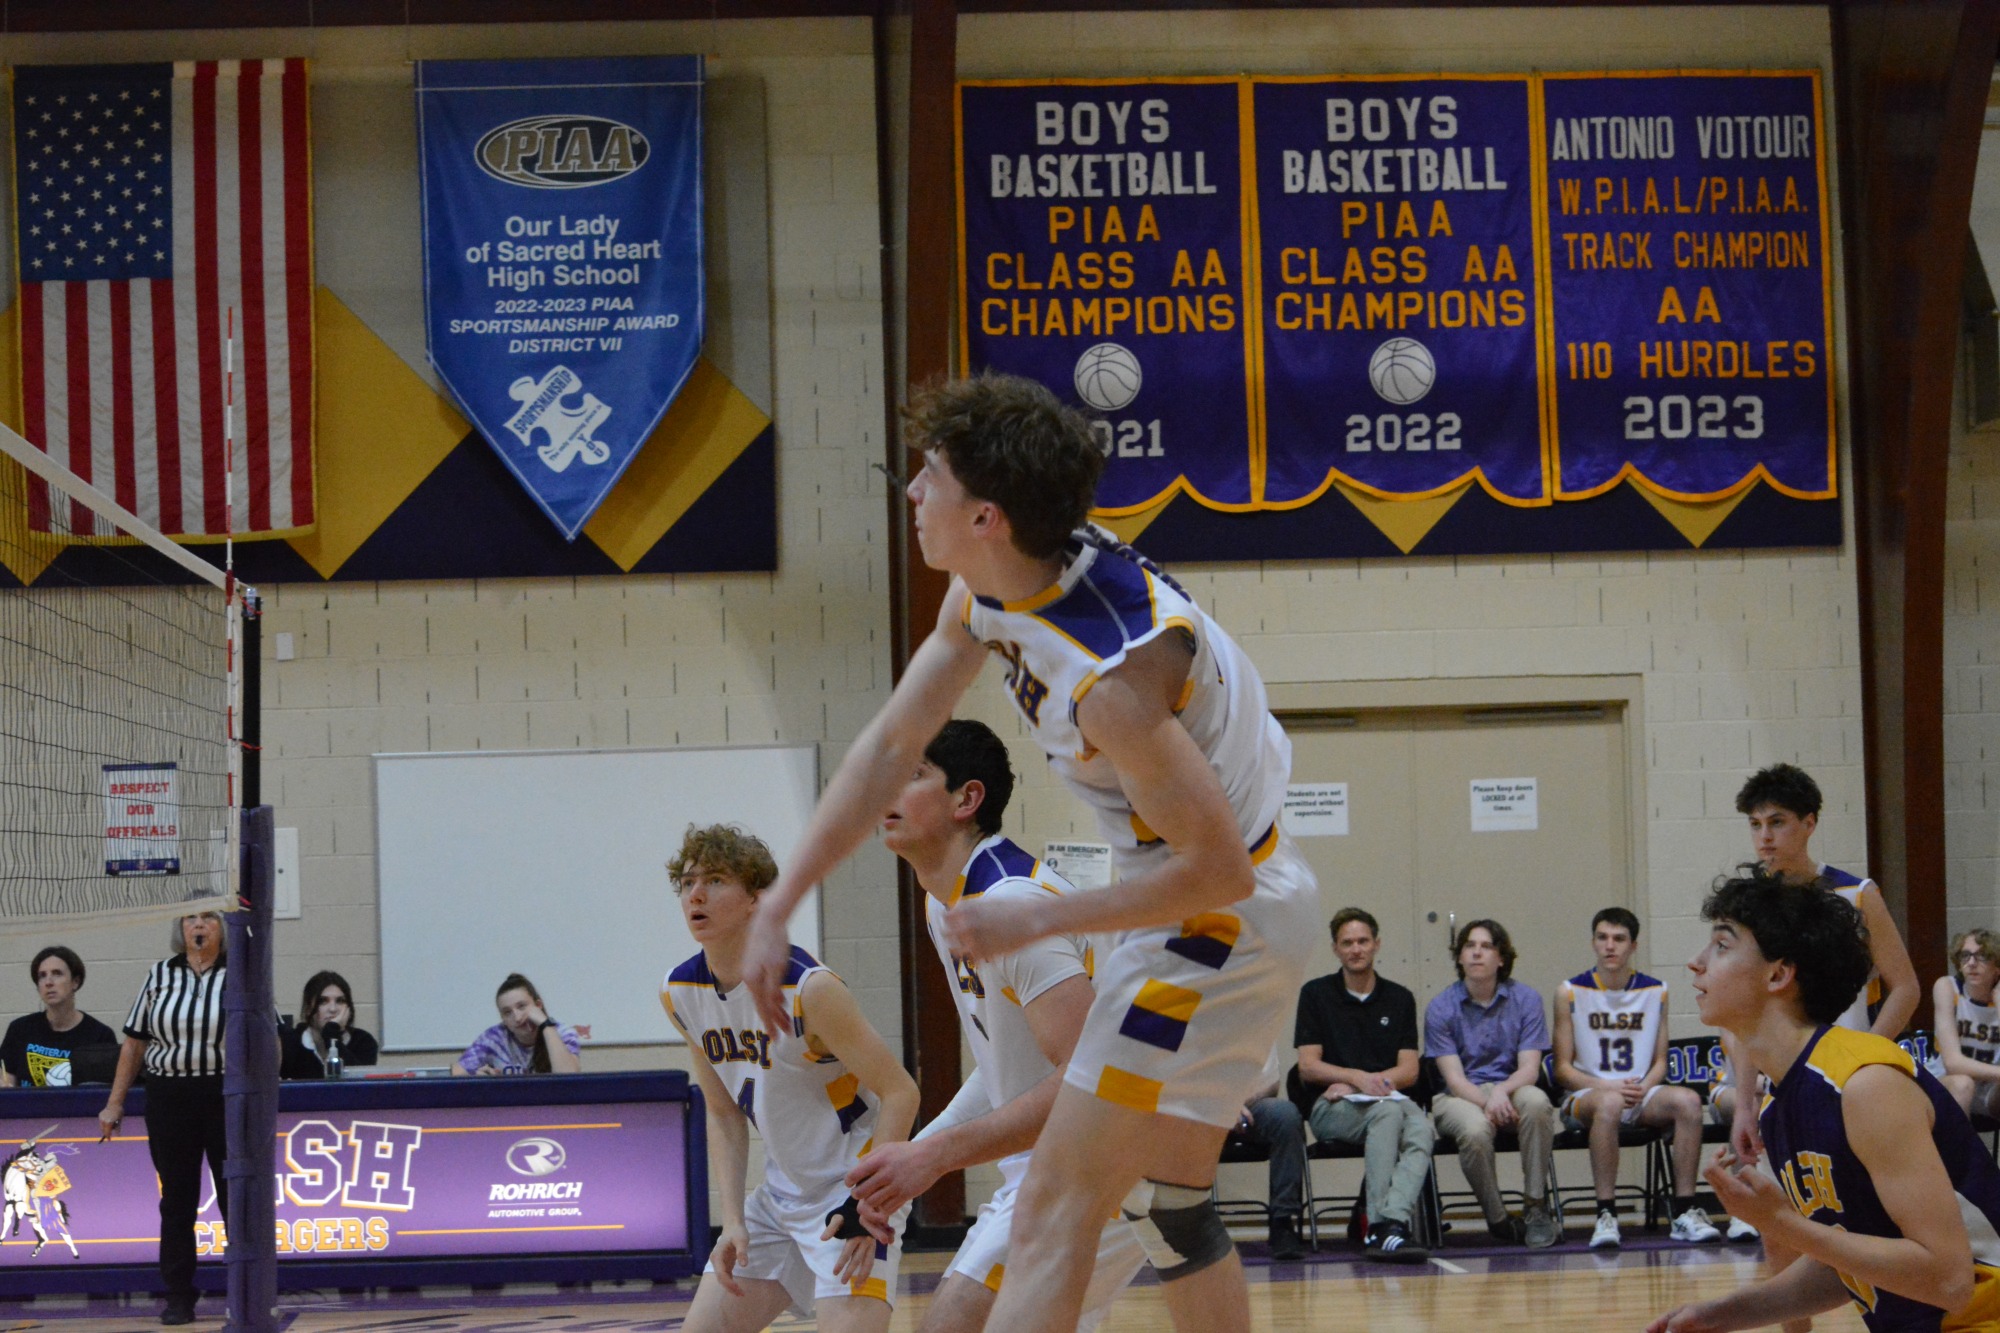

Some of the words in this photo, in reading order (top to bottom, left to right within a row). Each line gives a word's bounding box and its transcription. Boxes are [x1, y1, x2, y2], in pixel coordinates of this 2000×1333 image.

[1036, 99, 1170, 146] BOYS
[1326, 96, 1458, 142] BOYS
[1552, 116, 1675, 160] ANTONIO
[1696, 115, 1810, 159] VOTOUR
[501, 127, 637, 174] PIAA
[991, 151, 1217, 198] BASKETBALL
[1283, 147, 1507, 193] BASKETBALL
[505, 216, 552, 237] Our
[559, 214, 619, 240] Lady
[1049, 204, 1161, 244] PIAA
[1341, 200, 1453, 239] PIAA
[466, 242, 490, 263] of
[497, 240, 585, 262] Sacred
[593, 239, 661, 260] Heart
[987, 251, 1135, 290] CLASS
[1171, 248, 1227, 288] AA
[1281, 246, 1427, 285] CLASS
[1463, 244, 1518, 283] AA
[1562, 232, 1652, 270] TRACK
[1673, 231, 1809, 268] CHAMPION
[487, 266, 545, 292] High
[553, 264, 640, 286] School
[449, 317, 609, 334] SPORTSMANSHIP
[613, 314, 679, 331] AWARD
[494, 298, 586, 314] 2022-2023
[591, 297, 634, 311] PIAA
[981, 293, 1236, 336] CHAMPIONS
[1275, 289, 1526, 330] CHAMPIONS
[1657, 286, 1722, 324] AA
[508, 337, 596, 354] DISTRICT
[600, 337, 622, 351] VII
[1567, 341, 1613, 380] 110
[1639, 340, 1816, 379] HURDLES
[513, 370, 572, 434] SPORTSMANSHIP
[1623, 395, 1764, 440] 2023
[1090, 419, 1165, 458] 021
[1346, 412, 1462, 452] 2022
[110, 782, 170, 794] RESPECT
[1284, 800, 1317, 808] permitted
[1482, 794, 1506, 802] LOCKED
[127, 804, 154, 816] OUR
[107, 825, 177, 838] OFFICIALS
[1067, 846, 1108, 854] EMERGENCY
[1588, 1012, 1644, 1030] OLSH
[1599, 1037, 1634, 1072] 13
[489, 1182, 583, 1201] ROHRICH
[488, 1208, 546, 1218] AUTOMOTIVE
[194, 1217, 389, 1255] CHRGERS
